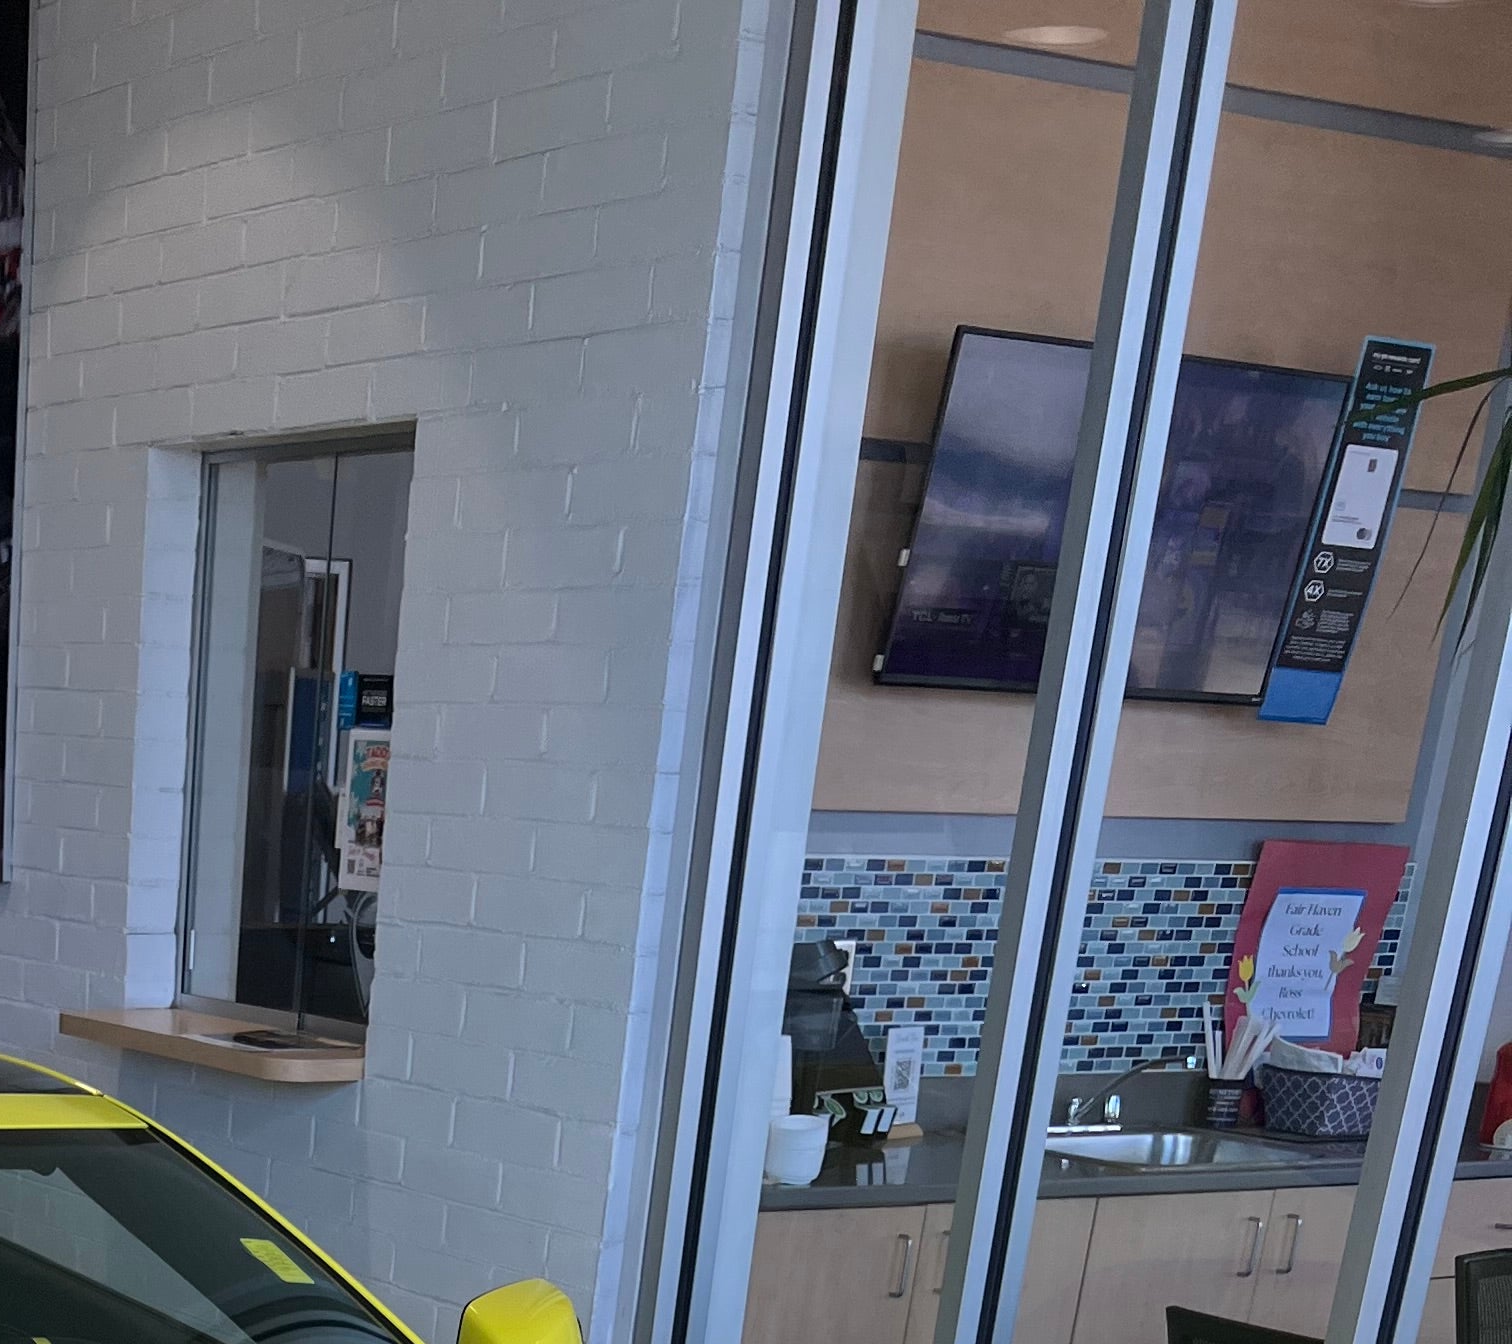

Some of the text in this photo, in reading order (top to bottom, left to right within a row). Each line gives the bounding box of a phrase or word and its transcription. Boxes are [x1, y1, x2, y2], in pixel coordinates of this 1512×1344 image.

[1285, 903, 1342, 917] Fair Haven
[1289, 923, 1324, 937] Grade
[1282, 943, 1320, 957] School
[1267, 964, 1301, 978] thanks
[1278, 987, 1303, 999] Ross
